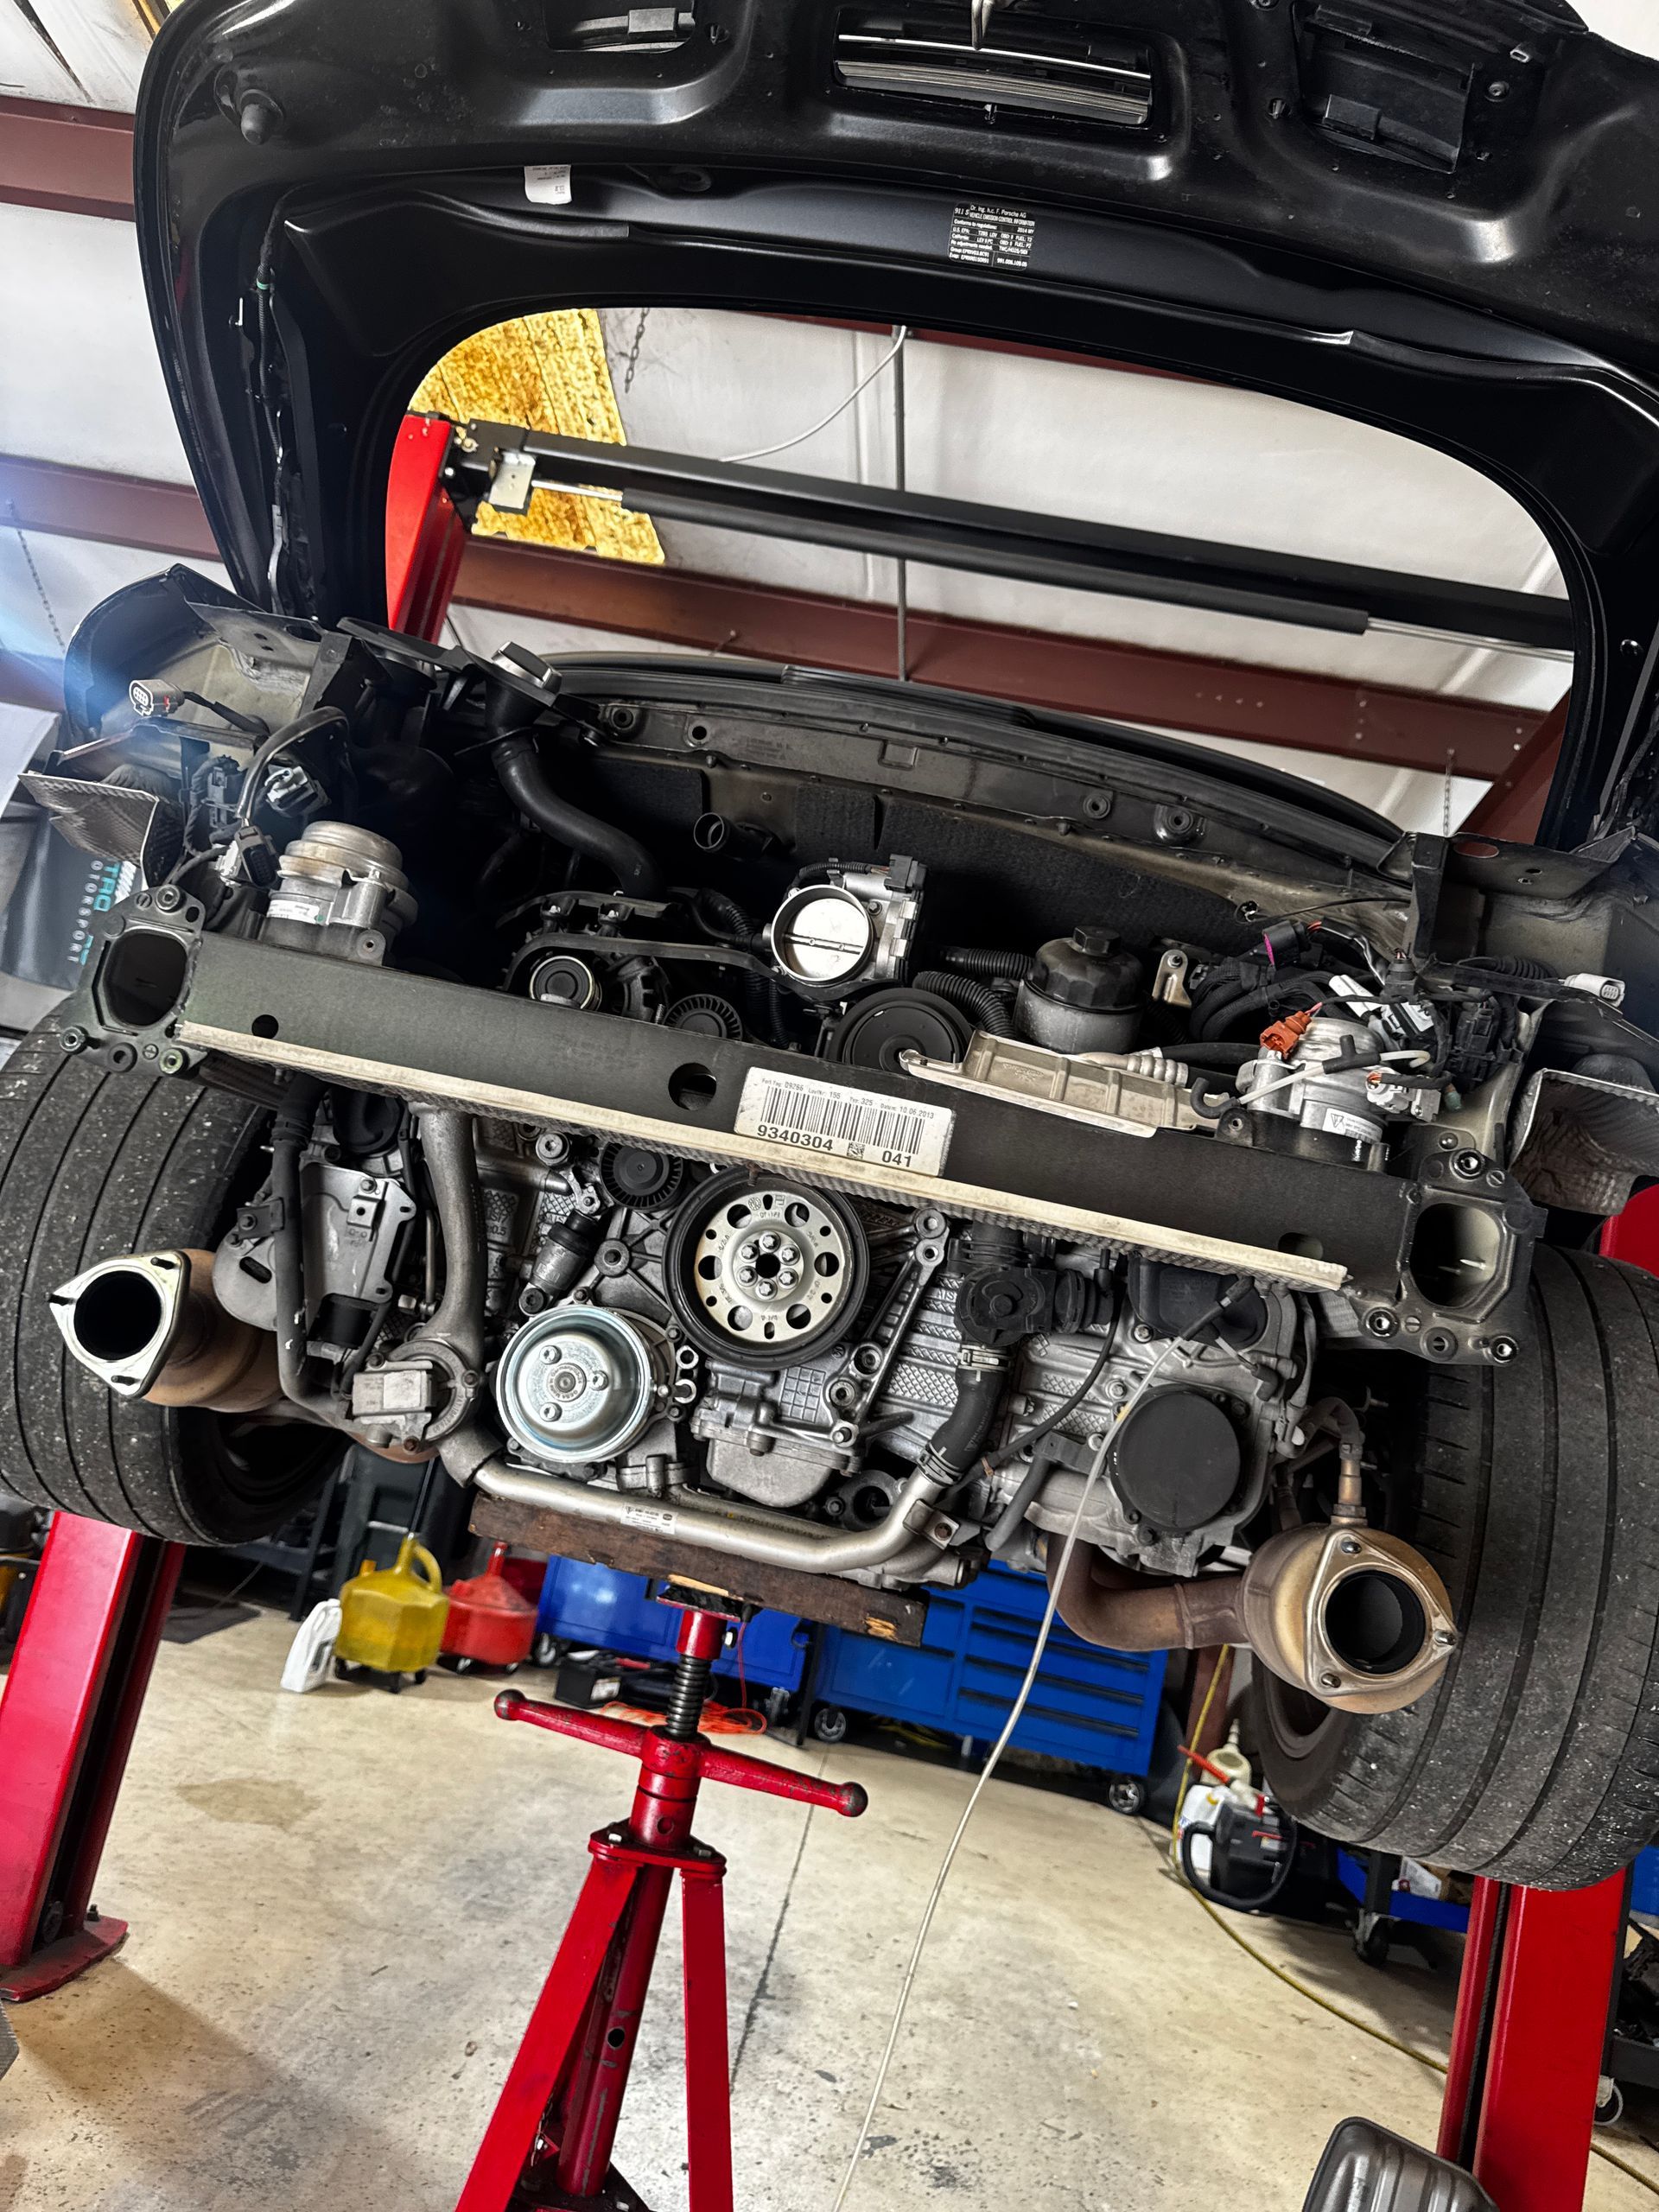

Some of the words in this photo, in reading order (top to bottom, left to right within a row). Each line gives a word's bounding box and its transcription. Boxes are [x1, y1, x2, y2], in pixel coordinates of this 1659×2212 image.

[1001, 209, 1019, 218] Porsche
[861, 1097, 873, 1106] 325
[757, 1124, 834, 1152] 9340304
[881, 1150, 912, 1168] 041
